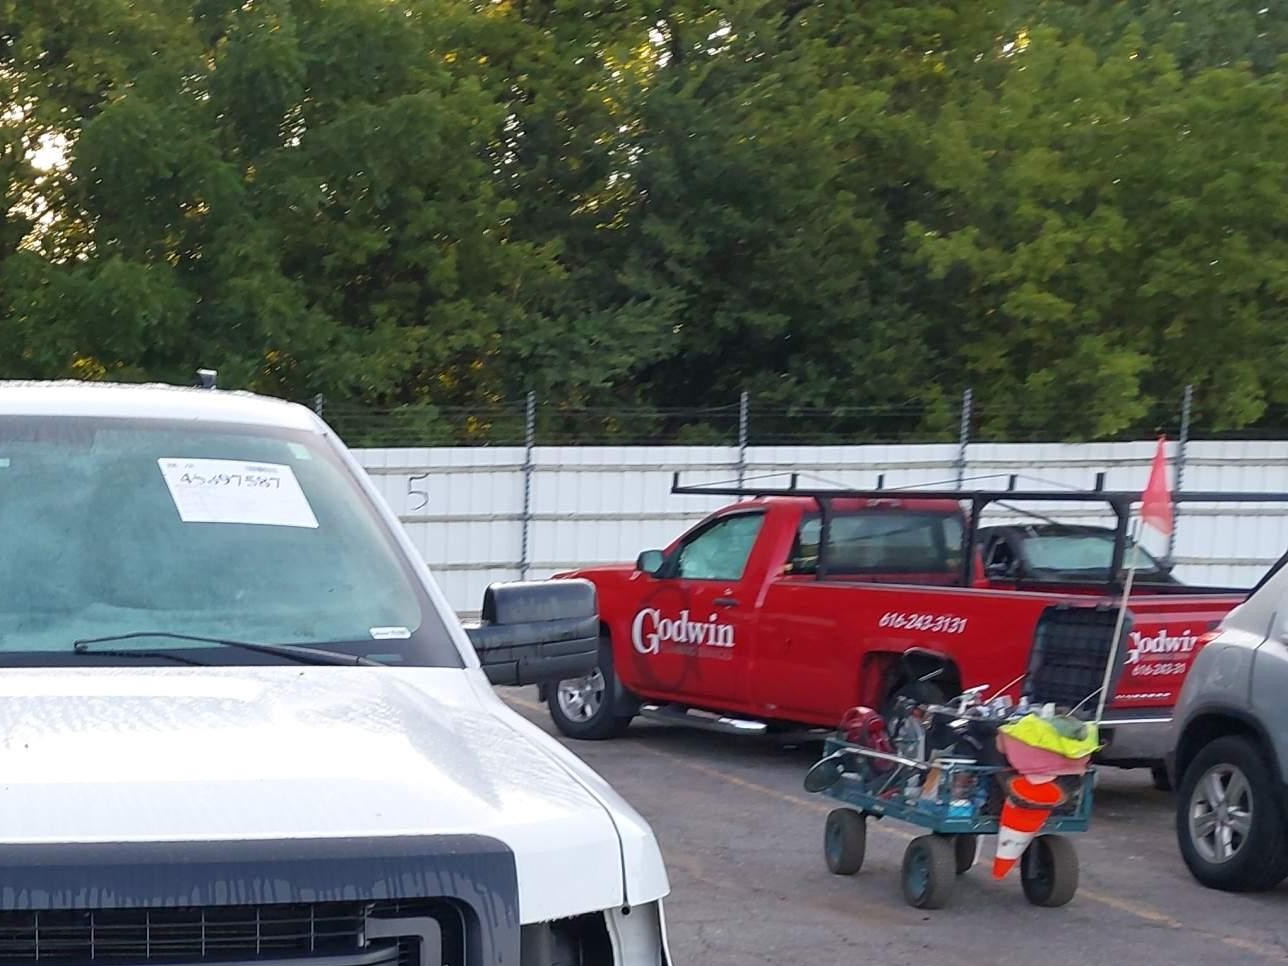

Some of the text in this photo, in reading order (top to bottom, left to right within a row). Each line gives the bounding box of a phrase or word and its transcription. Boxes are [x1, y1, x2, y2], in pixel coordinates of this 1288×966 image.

[408, 472, 430, 511] 5
[632, 607, 737, 655] Godwin
[879, 612, 968, 634] 616-243-3131
